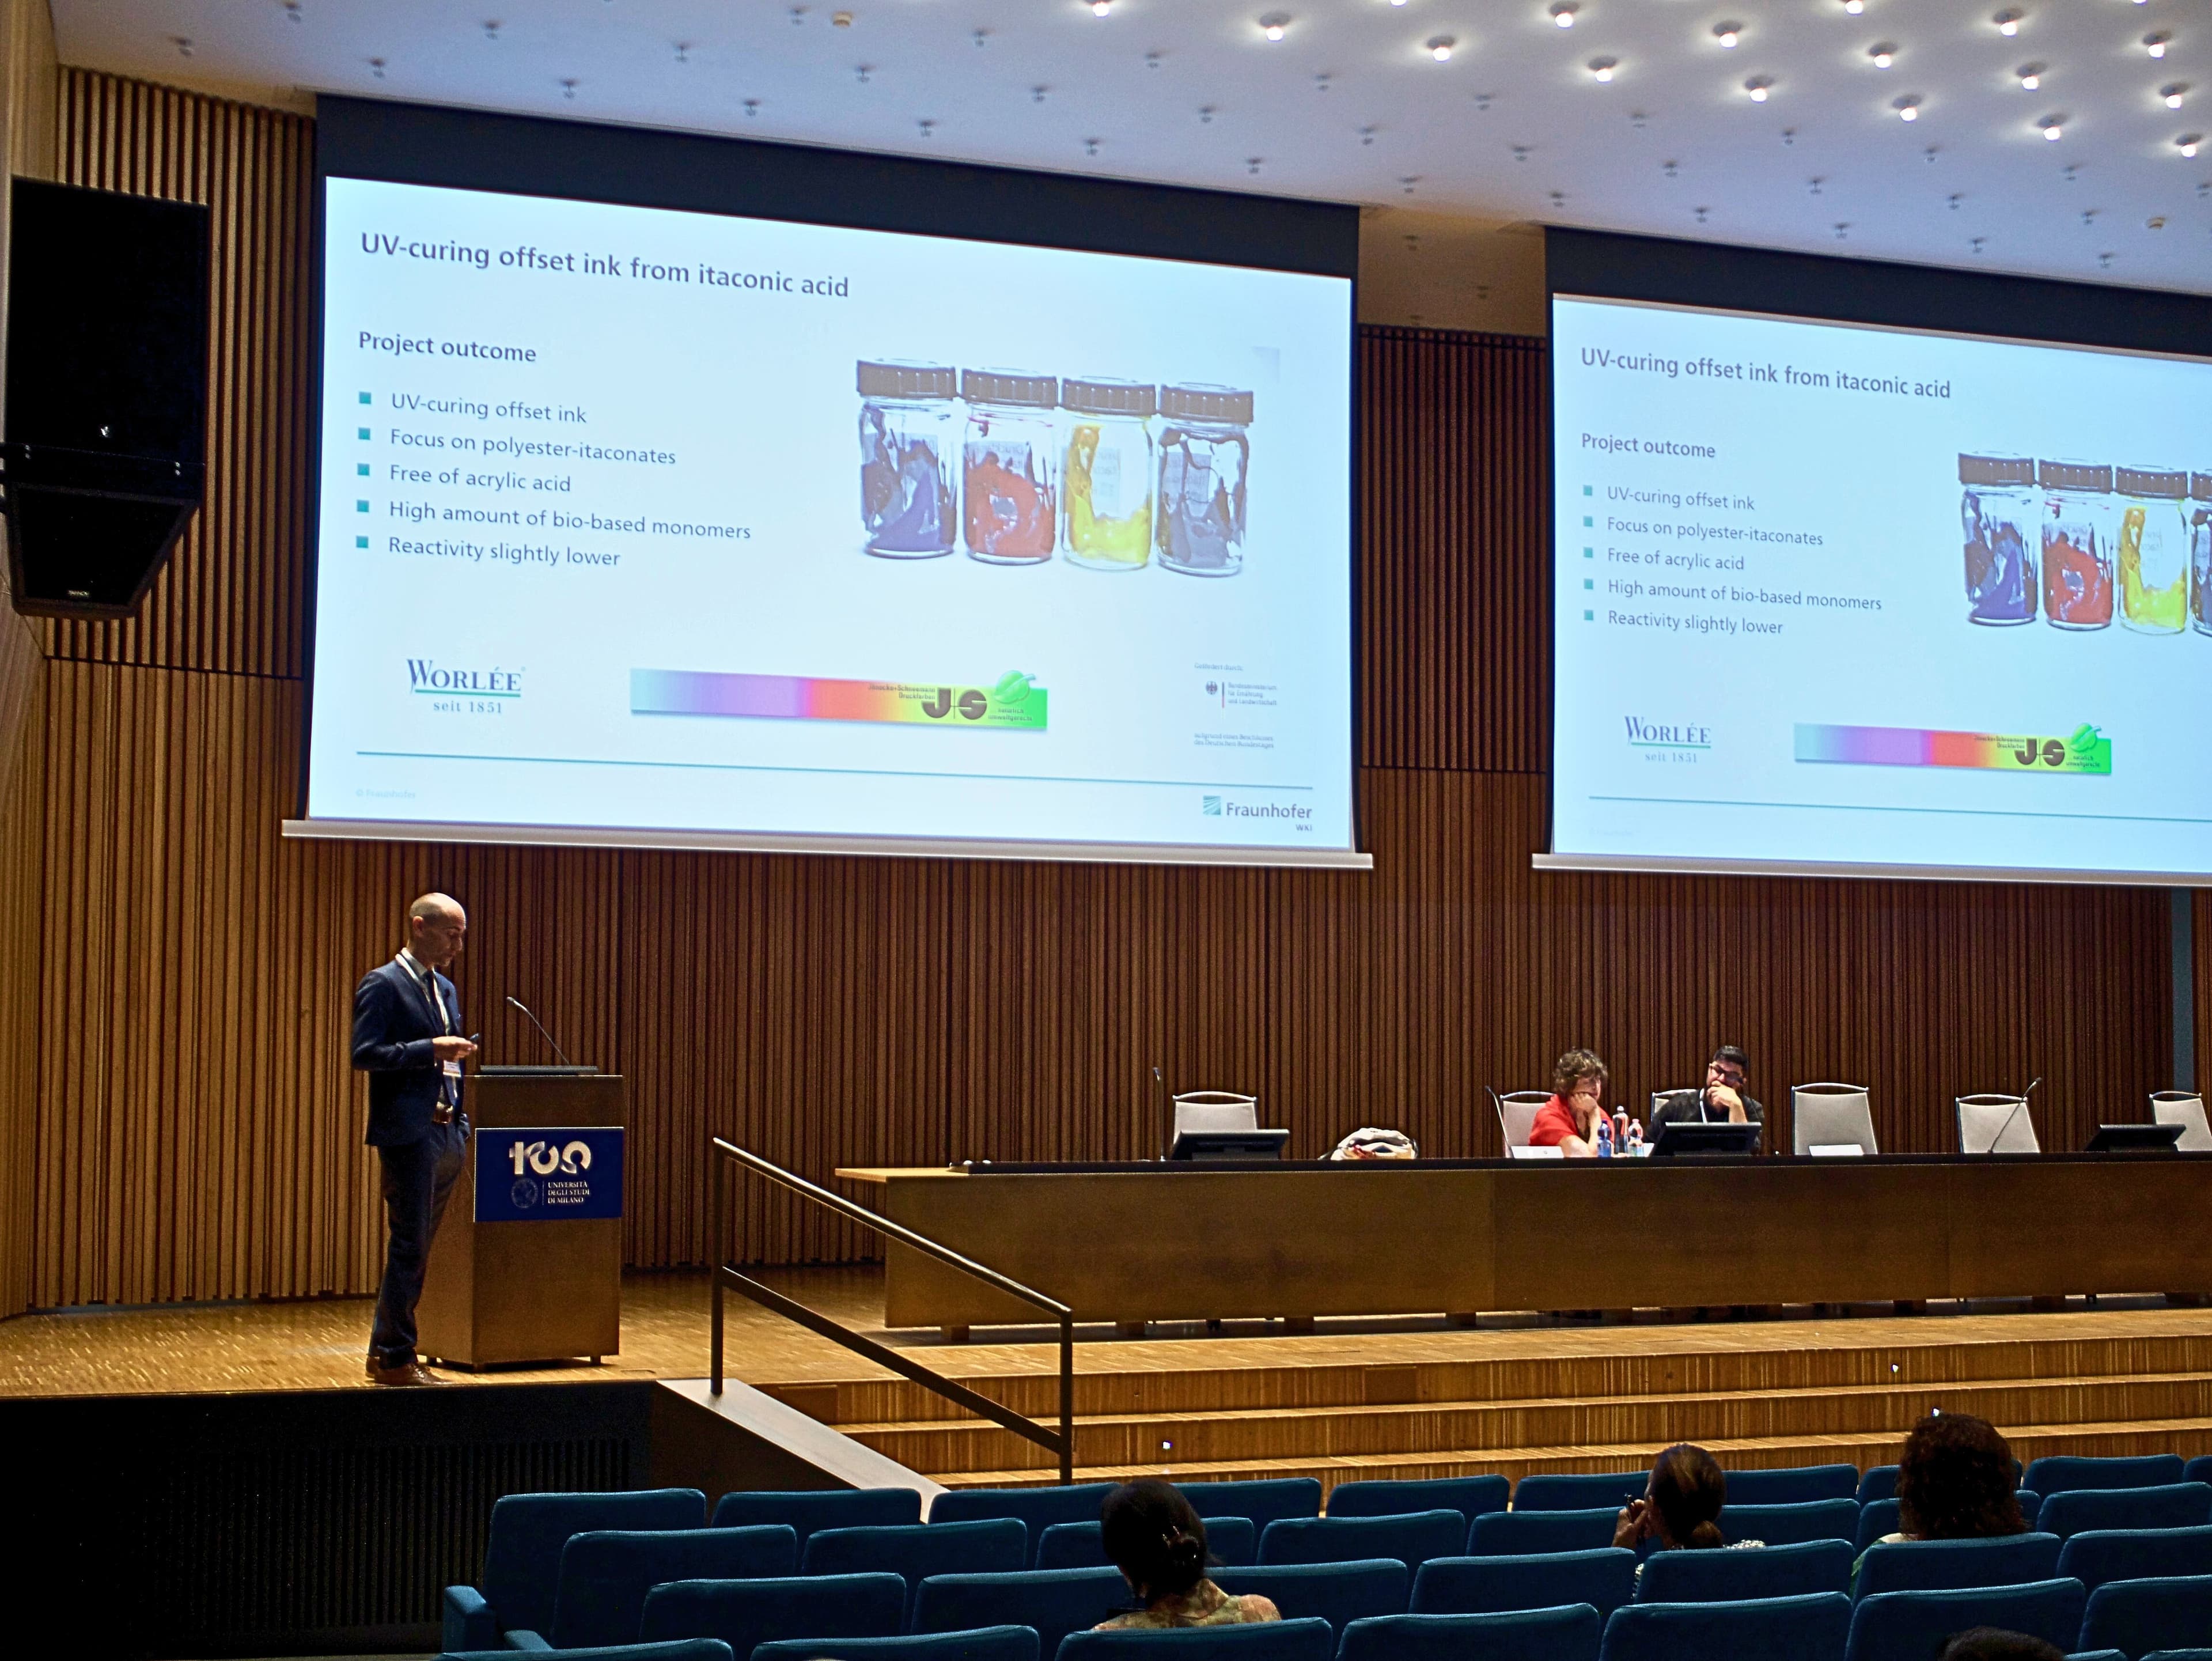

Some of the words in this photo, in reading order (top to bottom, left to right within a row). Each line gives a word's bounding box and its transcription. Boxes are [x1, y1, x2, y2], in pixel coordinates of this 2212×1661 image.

[361, 232, 490, 270] UV-curing
[499, 245, 575, 273] offset
[584, 252, 622, 277] ink
[630, 256, 689, 283] from
[699, 263, 793, 293] itaconic
[801, 275, 849, 298] acid
[359, 331, 434, 357] Project
[441, 341, 537, 362] outcome
[1581, 347, 1679, 379] UV-curing
[1685, 357, 1743, 380] offset
[1749, 362, 1778, 383] ink
[1784, 365, 1830, 388] from
[1836, 370, 1908, 395] itaconic
[1914, 379, 1950, 399] acid
[392, 392, 488, 420] UV-curing
[495, 400, 551, 421] offset
[559, 405, 587, 423] ink
[391, 428, 445, 448] Focus
[451, 437, 476, 451] on
[483, 436, 676, 464] polyester-itaconates
[1582, 433, 1639, 454] Project
[1643, 440, 1716, 459] outcome
[390, 464, 432, 483] Free
[438, 467, 460, 485] of
[465, 471, 526, 492] acrylic
[532, 475, 571, 492] acid
[1608, 486, 1681, 509] UV-curing
[1685, 491, 1728, 509] offset
[1733, 494, 1755, 510] ink
[390, 501, 435, 523] High
[442, 508, 520, 525] amount
[526, 509, 547, 526] of
[553, 510, 645, 533] bio-based
[652, 521, 751, 539] monomers
[1608, 516, 1649, 533] Focus
[1653, 524, 1672, 535] on
[1677, 522, 1823, 546] polyester-itaconates
[389, 536, 484, 562] Reactivity
[490, 542, 560, 567] slightly
[567, 546, 621, 566] lower
[1608, 547, 1640, 563] Free
[1644, 550, 1660, 565] of
[1665, 553, 1710, 571] acrylic
[1715, 555, 1744, 570] acid
[1608, 579, 1643, 598] High
[1648, 585, 1706, 599] amount
[1711, 585, 1726, 600] of
[1731, 586, 1801, 605] bio-based
[1806, 595, 1882, 610] monomers
[1608, 610, 1680, 632] Reactivity
[1684, 614, 1737, 635] slightly
[1742, 617, 1783, 634] lower
[406, 659, 521, 695] WORLÉE
[433, 700, 461, 712] seit
[469, 701, 502, 714] 1851
[1624, 716, 1711, 746] WORLÉE
[1645, 751, 1666, 762] seit
[1672, 752, 1696, 763] 1851
[1226, 802, 1313, 819] Fraunhofer
[1296, 823, 1313, 831] WKI
[548, 1181, 588, 1189] UNIVERSITÀ
